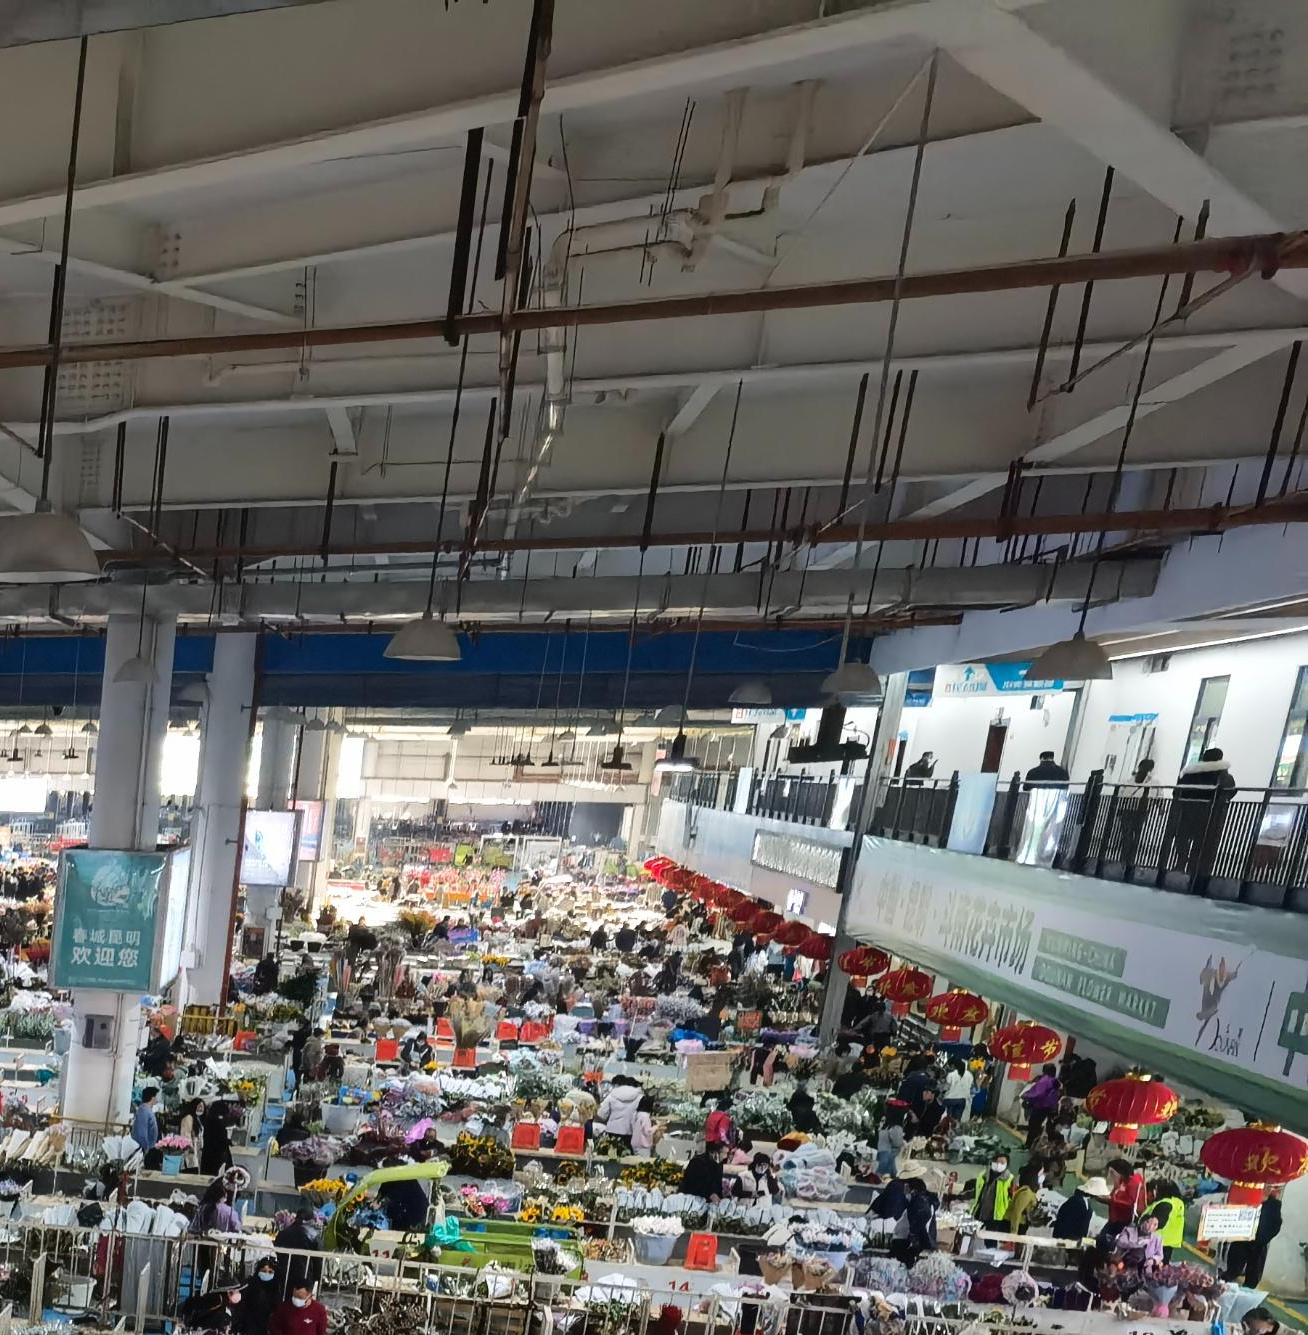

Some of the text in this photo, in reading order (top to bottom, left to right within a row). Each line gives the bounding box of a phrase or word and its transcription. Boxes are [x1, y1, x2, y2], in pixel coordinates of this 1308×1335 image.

[73, 927, 141, 947] 春城昆明
[71, 946, 140, 968] 欢迎您
